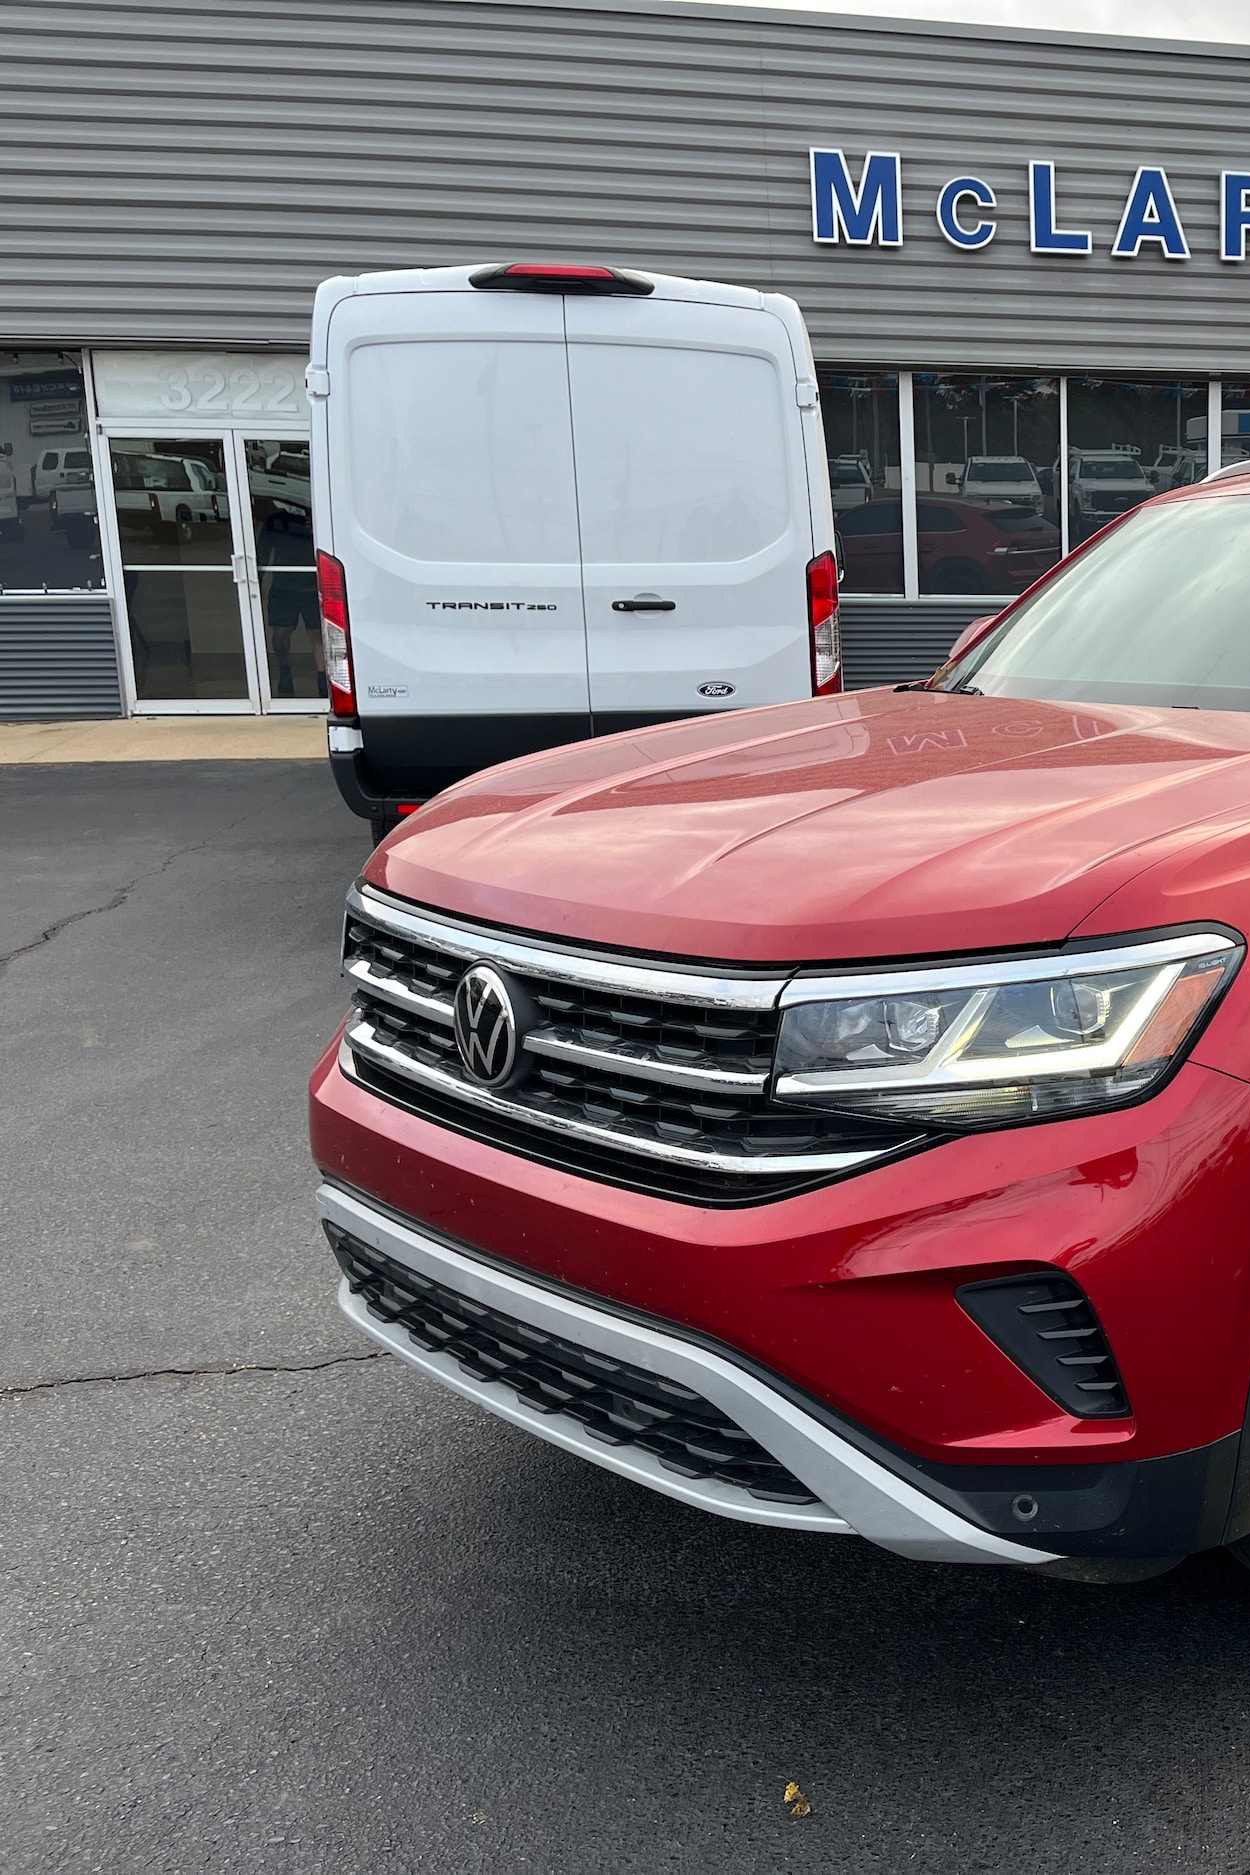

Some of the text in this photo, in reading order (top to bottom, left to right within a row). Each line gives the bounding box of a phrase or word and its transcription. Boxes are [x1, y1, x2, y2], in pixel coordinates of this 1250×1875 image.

[160, 367, 298, 412] 3222
[426, 602, 525, 610] TRANSIT
[368, 686, 397, 697] McLarty
